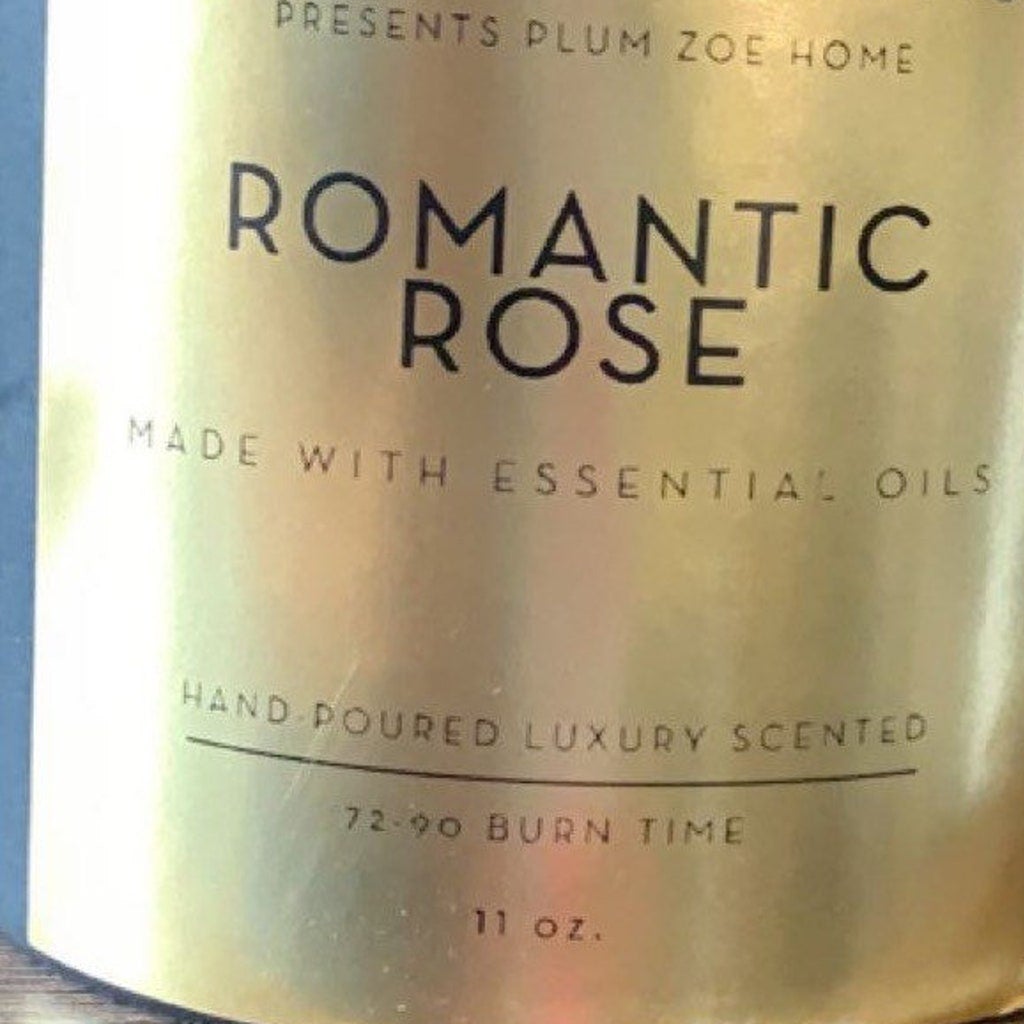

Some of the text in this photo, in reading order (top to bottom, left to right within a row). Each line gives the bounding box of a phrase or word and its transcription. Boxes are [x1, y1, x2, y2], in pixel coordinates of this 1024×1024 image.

[526, 18, 651, 58] PLUM
[677, 30, 764, 66] ZOE
[790, 38, 913, 75] HOME
[228, 160, 931, 293] ROMANTIC
[401, 278, 747, 387] ROSE
[129, 415, 992, 503] MADE WITH ESSENTIAL OILS
[524, 722, 706, 754] LUXURY
[732, 712, 927, 753] SCENTED
[487, 812, 611, 845] BURN
[642, 816, 745, 846] TIME
[474, 908, 506, 935] 11
